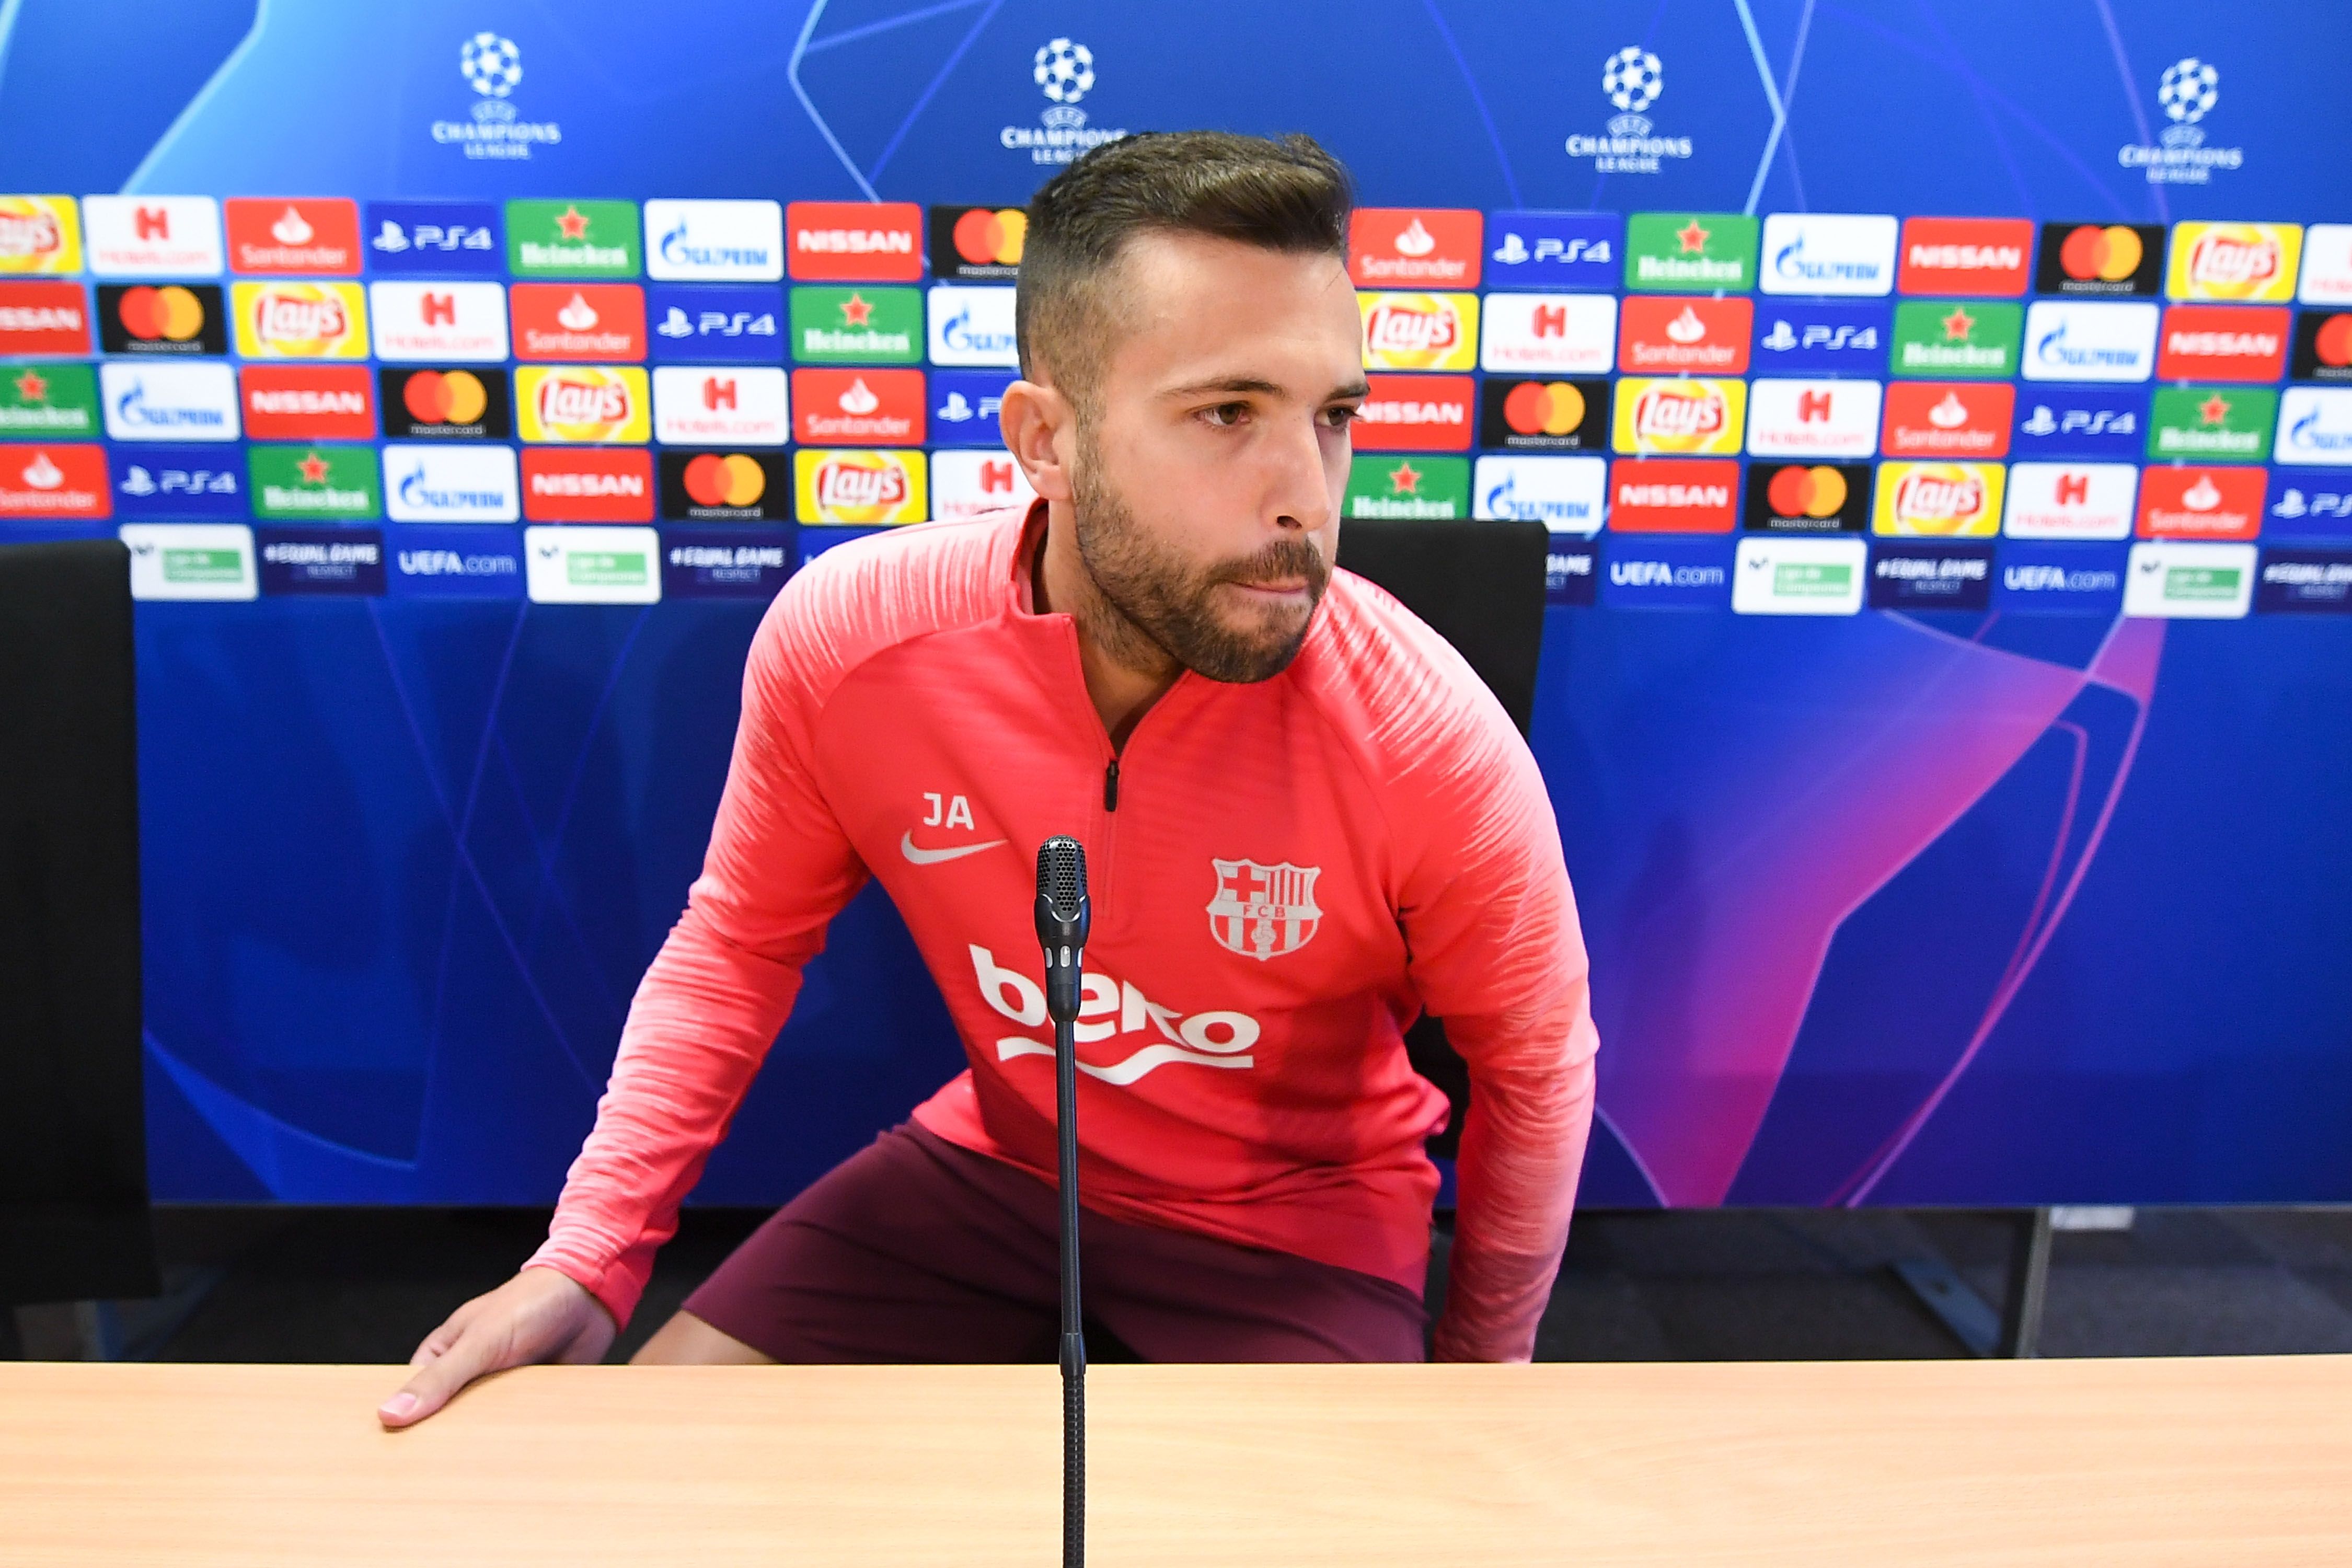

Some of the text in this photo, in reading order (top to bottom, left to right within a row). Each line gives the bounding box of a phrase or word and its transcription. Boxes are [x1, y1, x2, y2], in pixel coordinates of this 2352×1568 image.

[432, 121, 561, 143] CHAMPIONS
[1566, 135, 1692, 158] CHAMPIONS
[1596, 158, 1659, 172] LEAGUE
[414, 225, 493, 250] PS4
[797, 230, 912, 253] NISSAN
[240, 245, 345, 267] Santander
[521, 243, 628, 266] Heineken
[1534, 238, 1611, 263] PS4
[1908, 245, 2021, 269] NISSAN
[1362, 256, 1466, 279] Santander
[1638, 256, 1743, 281] Heineken
[2061, 281, 2134, 292] mastercard
[698, 312, 777, 337] PS4
[526, 329, 631, 353] Santander
[804, 330, 909, 352] Heineken
[1802, 325, 1877, 350] PS4
[2167, 332, 2278, 356] NISSAN
[1493, 346, 1600, 362] Hotels.com
[1633, 344, 1735, 366] Santander
[1903, 342, 2006, 367] Heineken
[250, 390, 364, 414] NISSAN
[1356, 401, 1464, 424] NISSAN
[411, 424, 483, 435] mastercard
[666, 418, 775, 433] Hotels.com
[807, 413, 910, 436] Santander
[2061, 411, 2136, 435] PS4
[1507, 435, 1579, 446] mastercard
[1759, 430, 1865, 446] Hotels.com
[1893, 426, 1997, 449] Santander
[2158, 426, 2261, 452] Heineken
[160, 469, 238, 494] PS4
[532, 474, 643, 497] NISSAN
[263, 486, 369, 510] Heineken
[1352, 495, 1456, 518] Heineken
[1619, 483, 1728, 508] NISSAN
[689, 507, 761, 517] mastercard
[1770, 518, 1840, 529] mastercard
[2147, 509, 2247, 532] Santander
[330, 543, 379, 565] GAME
[398, 550, 516, 575] UEFA.com
[670, 546, 783, 568] #EQUAL GAME
[712, 568, 760, 579] RESPECT
[1611, 561, 1724, 586] UEFA.com
[1875, 558, 1987, 580] #EQUAL GAME
[2003, 566, 2116, 591] UEFA.com
[923, 792, 975, 830] JA
[969, 944, 1260, 1052] beko
